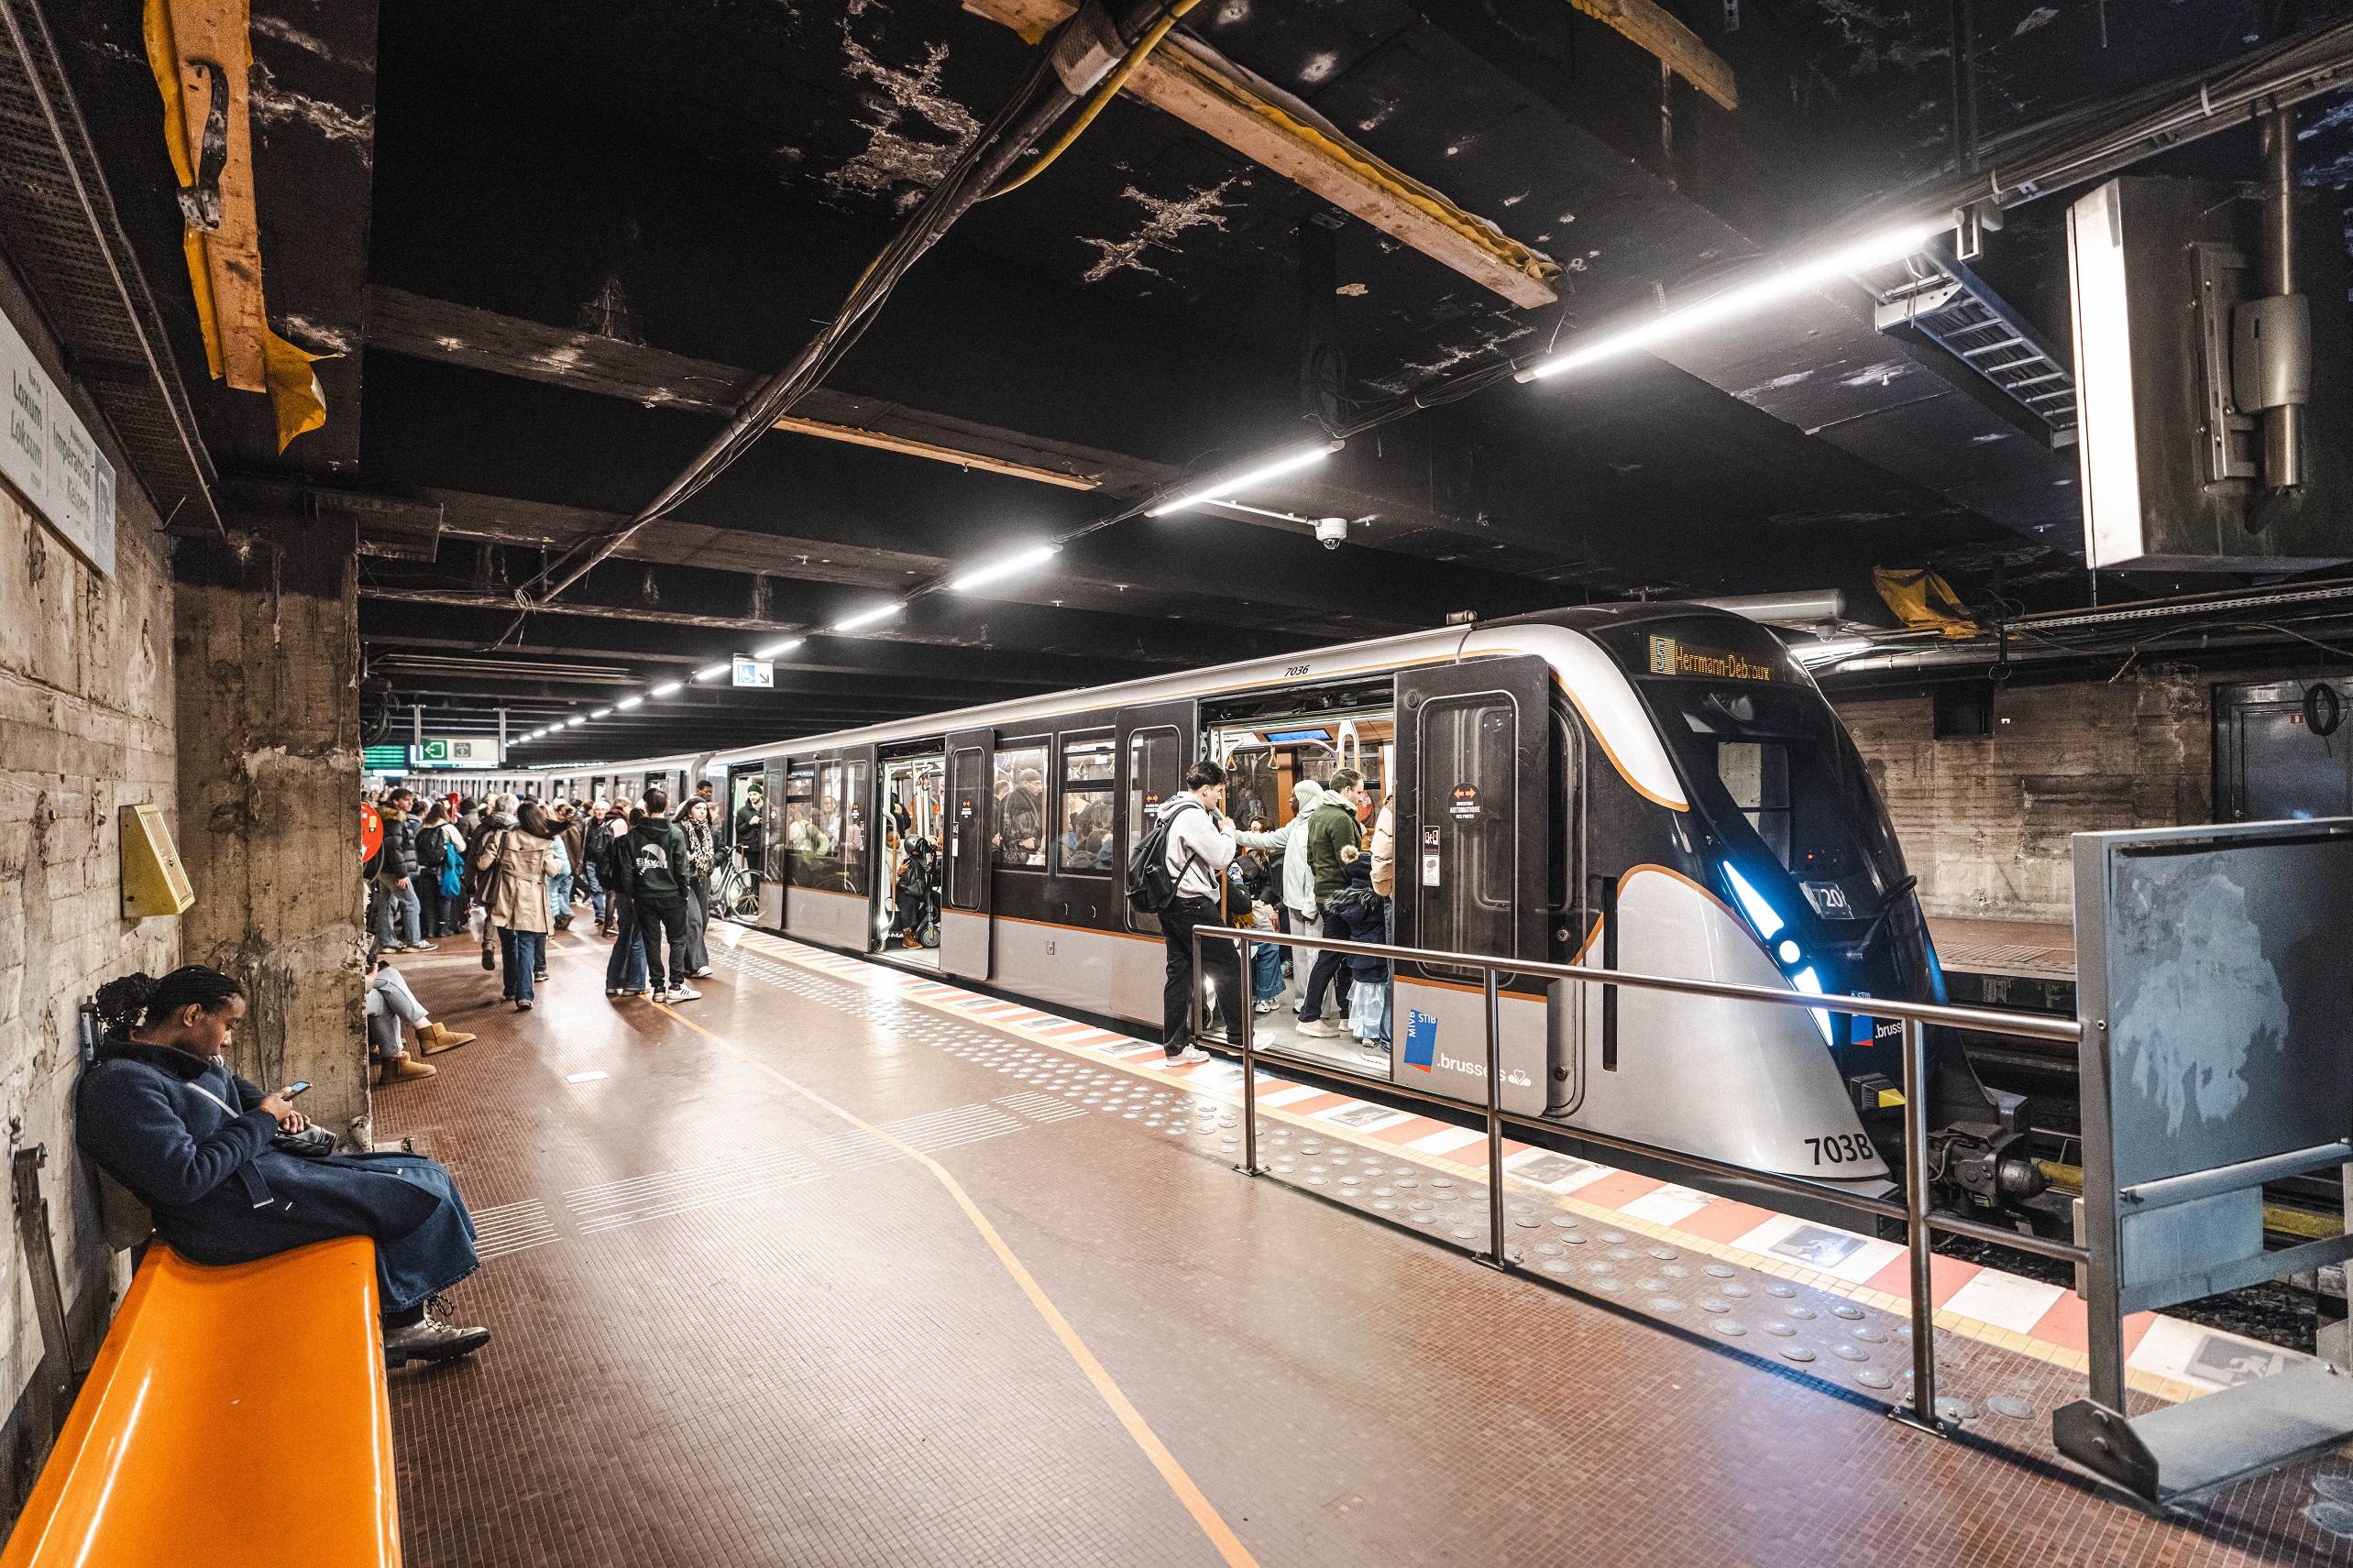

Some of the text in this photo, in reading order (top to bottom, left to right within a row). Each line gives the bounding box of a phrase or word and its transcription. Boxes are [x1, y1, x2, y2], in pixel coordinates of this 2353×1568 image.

[13, 368, 42, 431] Loxum
[11, 409, 42, 468] Loksum
[1418, 1013, 1436, 1025] STIB
[1804, 1133, 1875, 1166] 703B
